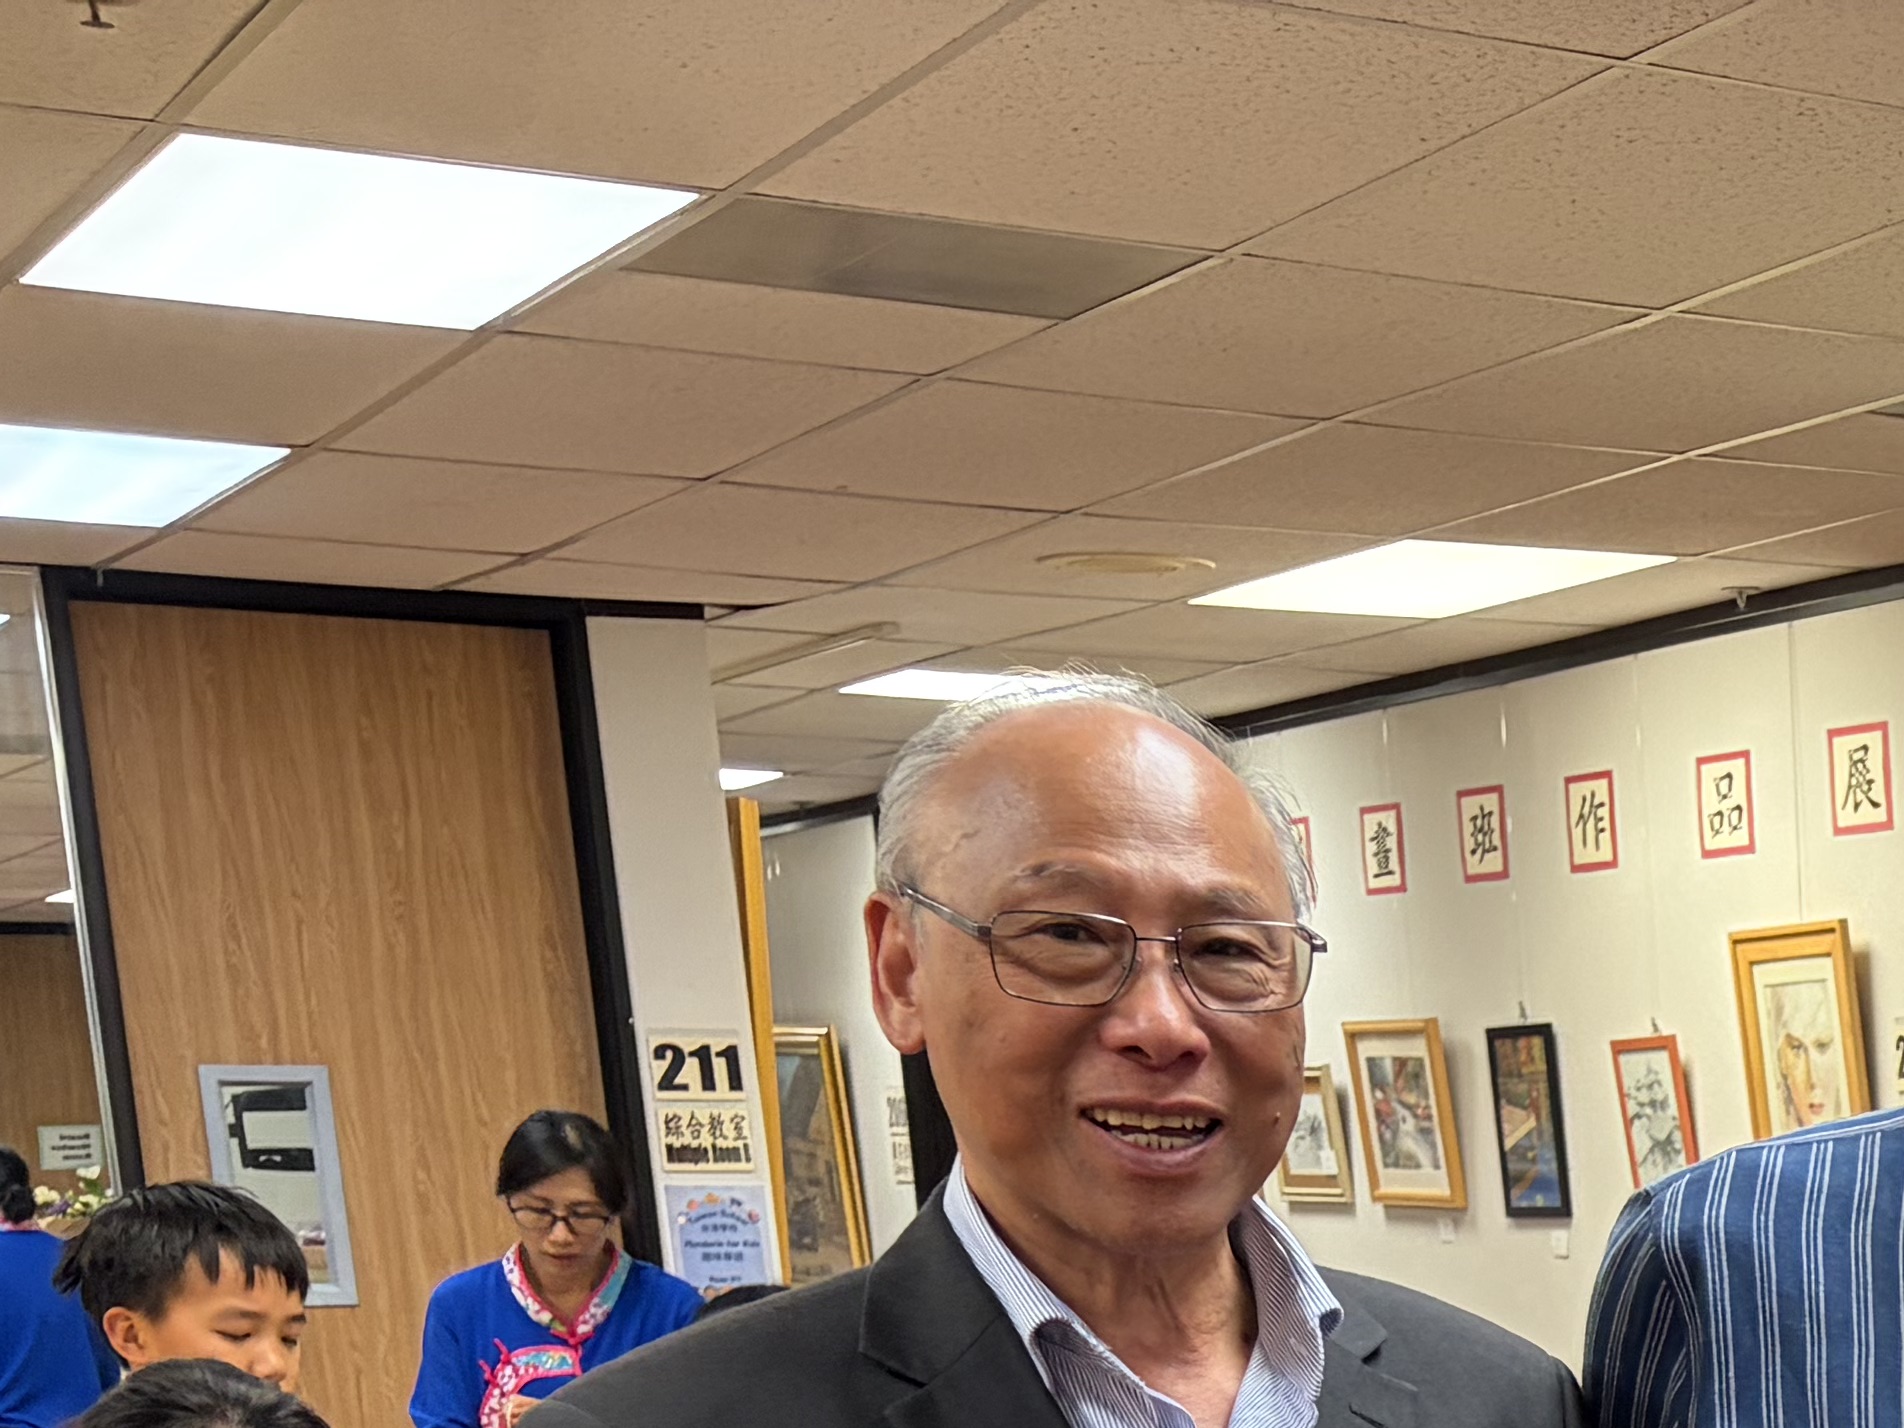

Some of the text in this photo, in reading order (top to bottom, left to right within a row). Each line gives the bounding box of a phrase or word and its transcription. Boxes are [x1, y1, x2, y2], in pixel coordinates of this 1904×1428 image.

[654, 1043, 744, 1092] 211
[664, 1110, 748, 1141] 綜合教室
